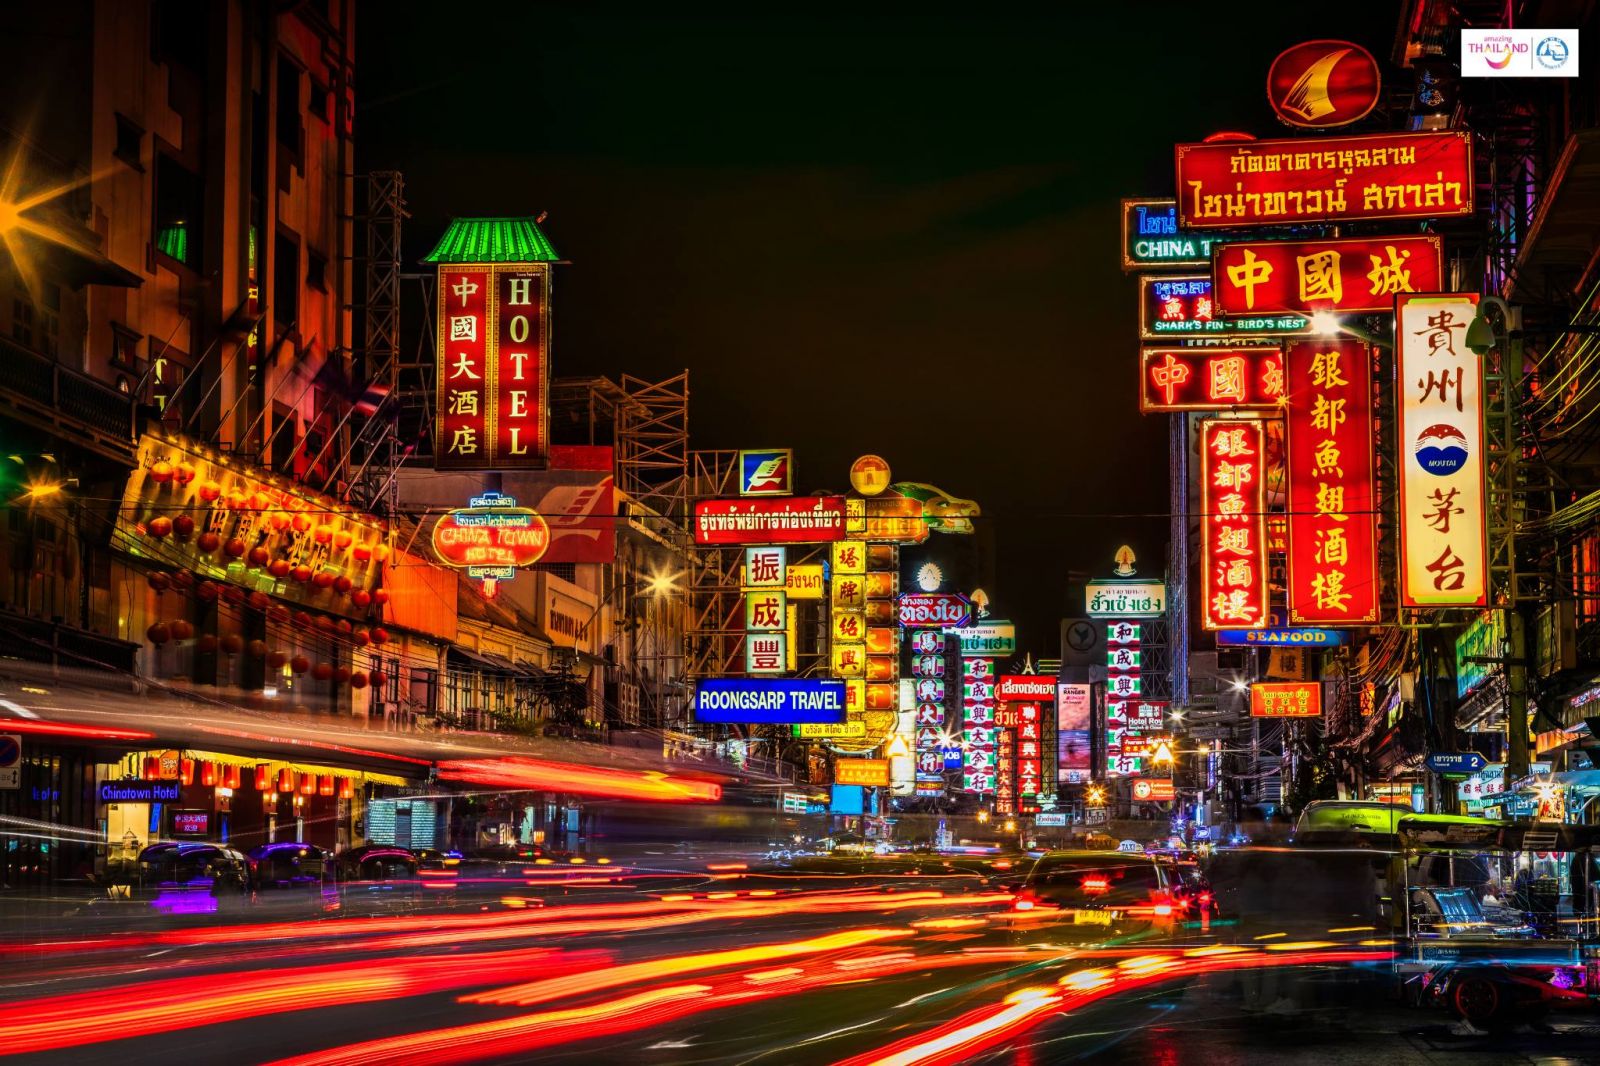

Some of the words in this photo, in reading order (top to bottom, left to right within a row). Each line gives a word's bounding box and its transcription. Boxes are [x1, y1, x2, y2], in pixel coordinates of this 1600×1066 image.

[1188, 179, 1347, 218] ไชน่าทาวน์
[1364, 171, 1462, 210] สกาล่า
[1135, 241, 1196, 257] CHINA
[1226, 246, 1415, 310] 中國城
[1155, 320, 1202, 330] SHARK'S
[1206, 321, 1224, 329] FIN
[1237, 319, 1274, 329] BIRD'S
[1277, 318, 1306, 328] NEST
[448, 276, 482, 456] 中國大酒店
[508, 278, 533, 456] HOTEL
[1428, 459, 1457, 467] MOUTAI
[1308, 351, 1353, 613] 銀都魚翅酒樓
[1210, 429, 1258, 622] 銀都魚翅酒樓
[440, 527, 492, 545] CHINA
[497, 528, 543, 546] TOWN
[466, 547, 516, 563] HOTEL
[1247, 631, 1327, 642] SEAFOOD
[700, 691, 786, 710] ROONGSARP
[790, 691, 842, 710] TRAVEL
[1471, 757, 1479, 767] 2
[102, 785, 151, 799] Chinatown
[153, 785, 178, 799] Hotel
